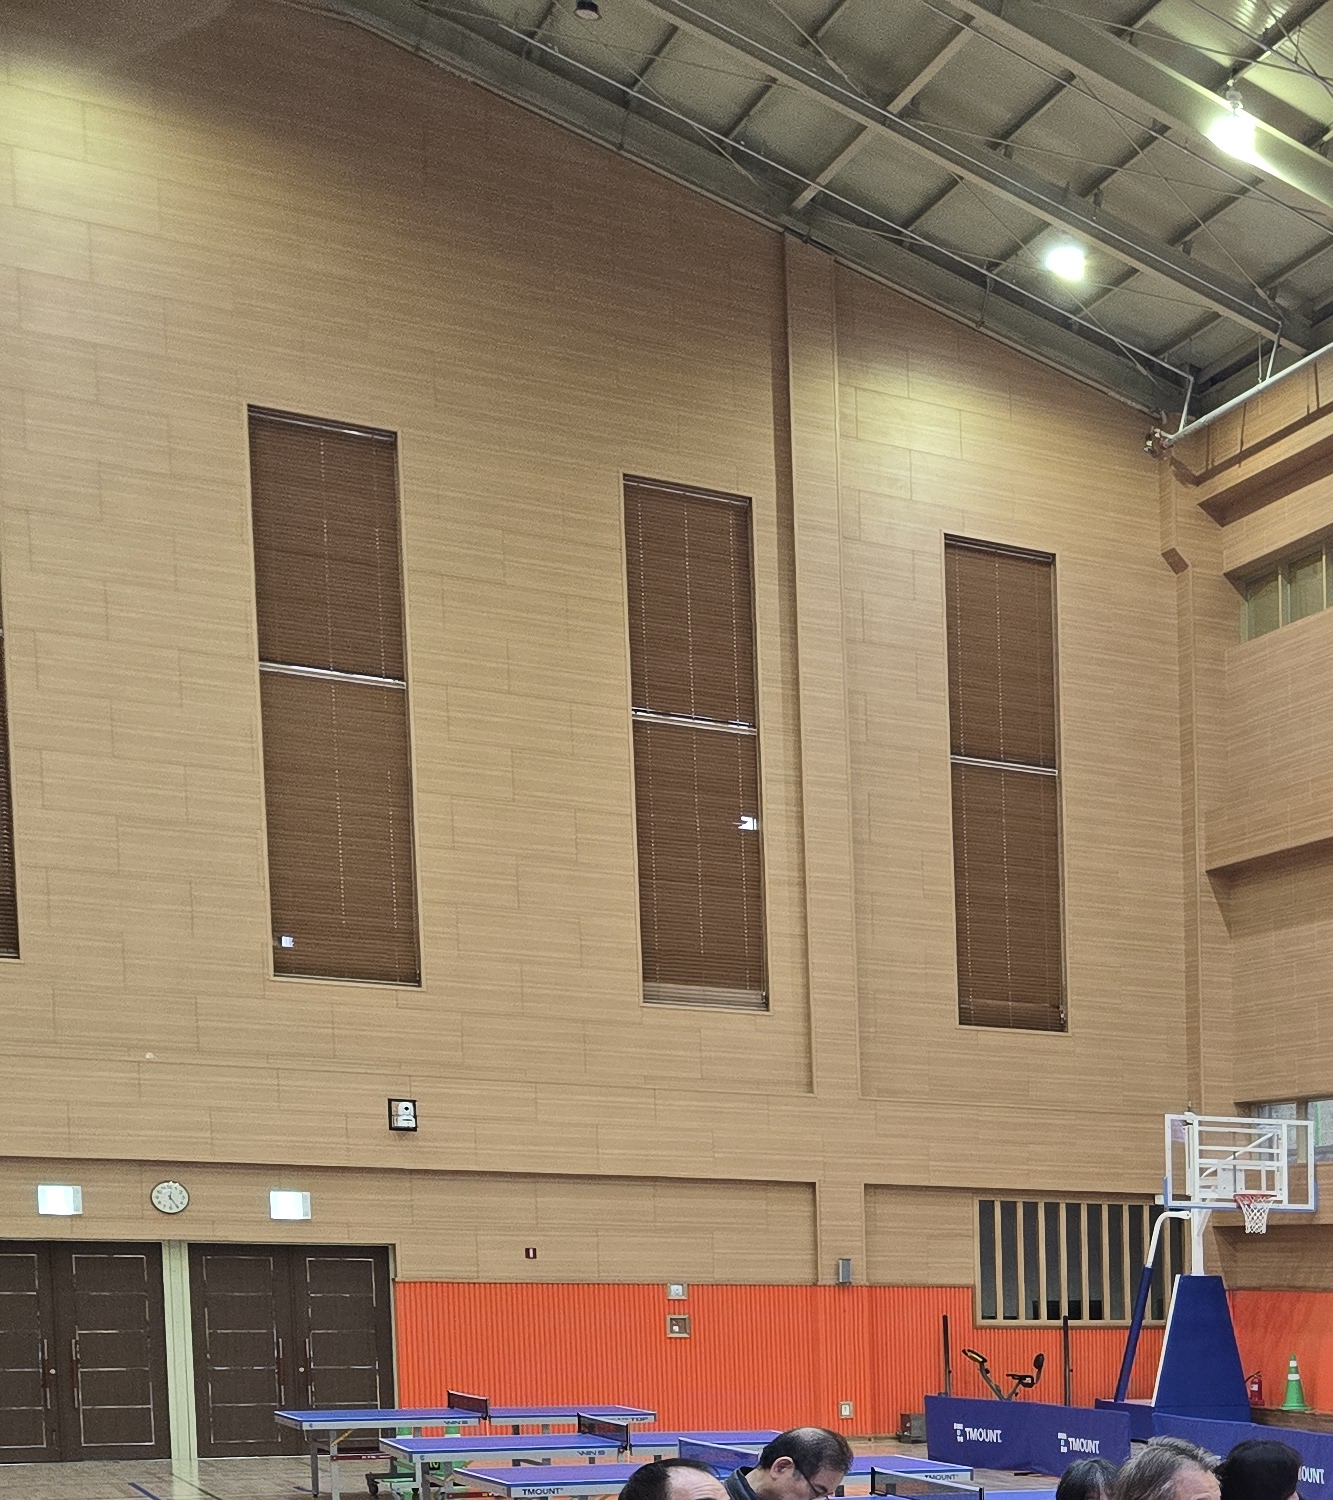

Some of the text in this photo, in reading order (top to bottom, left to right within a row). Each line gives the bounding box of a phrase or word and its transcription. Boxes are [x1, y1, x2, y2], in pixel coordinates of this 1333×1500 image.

[964, 1427, 1002, 1443] TMOUNT
[1068, 1437, 1100, 1454] TMOUNT
[1299, 1466, 1325, 1485] OUNT
[521, 1486, 561, 1496] TMOUNT
